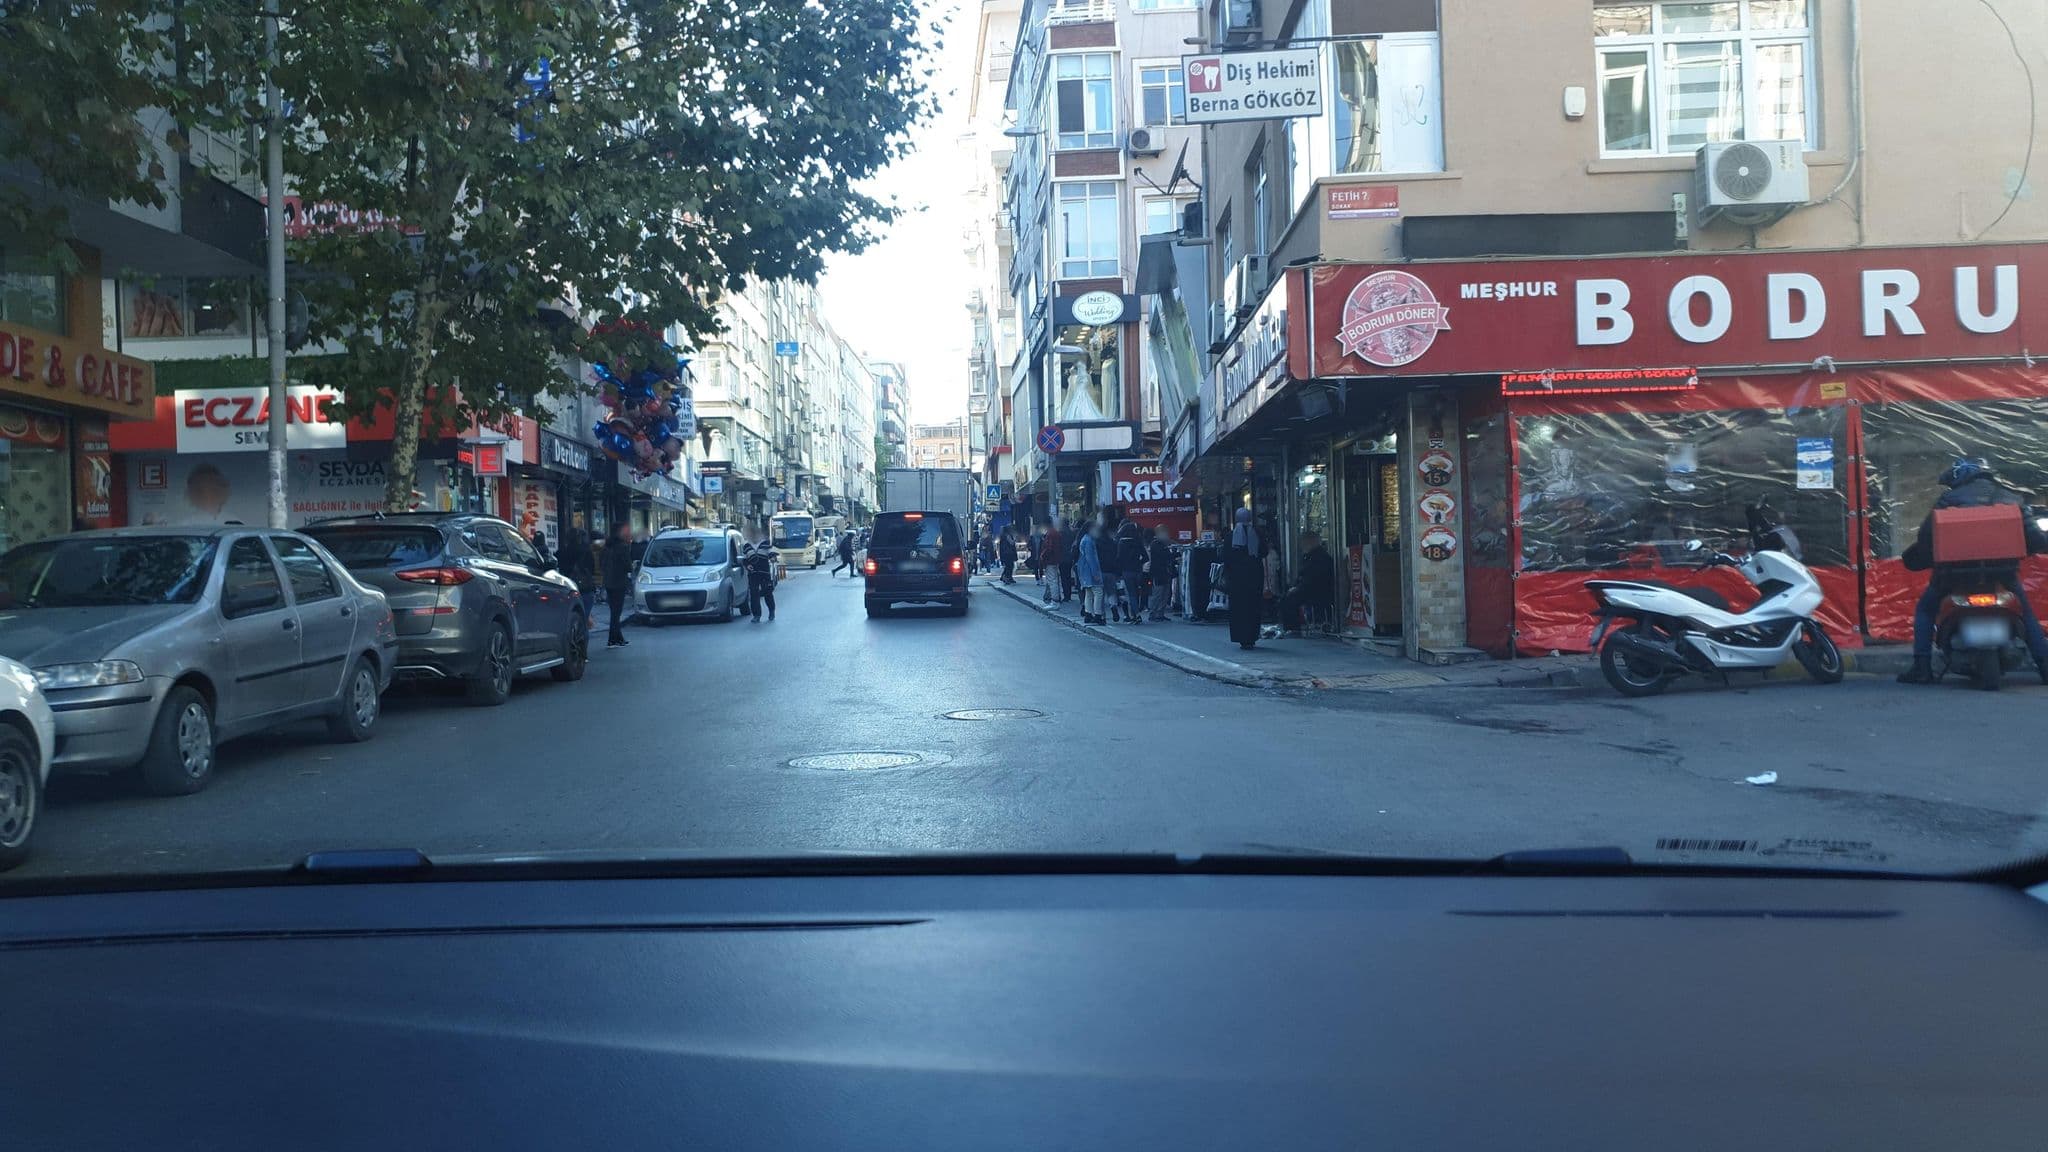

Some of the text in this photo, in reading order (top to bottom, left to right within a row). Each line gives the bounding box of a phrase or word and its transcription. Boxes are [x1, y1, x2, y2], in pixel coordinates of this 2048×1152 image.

[1226, 58, 1316, 85] Diş Hekimi
[1190, 88, 1317, 114] Berna GÖKGÖZ
[1460, 281, 1558, 302] MEŞHUR
[1347, 306, 1436, 340] BODRUM DÖNER
[75, 353, 144, 405] CAFE
[234, 431, 269, 445] SEV
[144, 465, 161, 485] E
[319, 461, 385, 477] SEVDA
[1132, 465, 1163, 475] GALE
